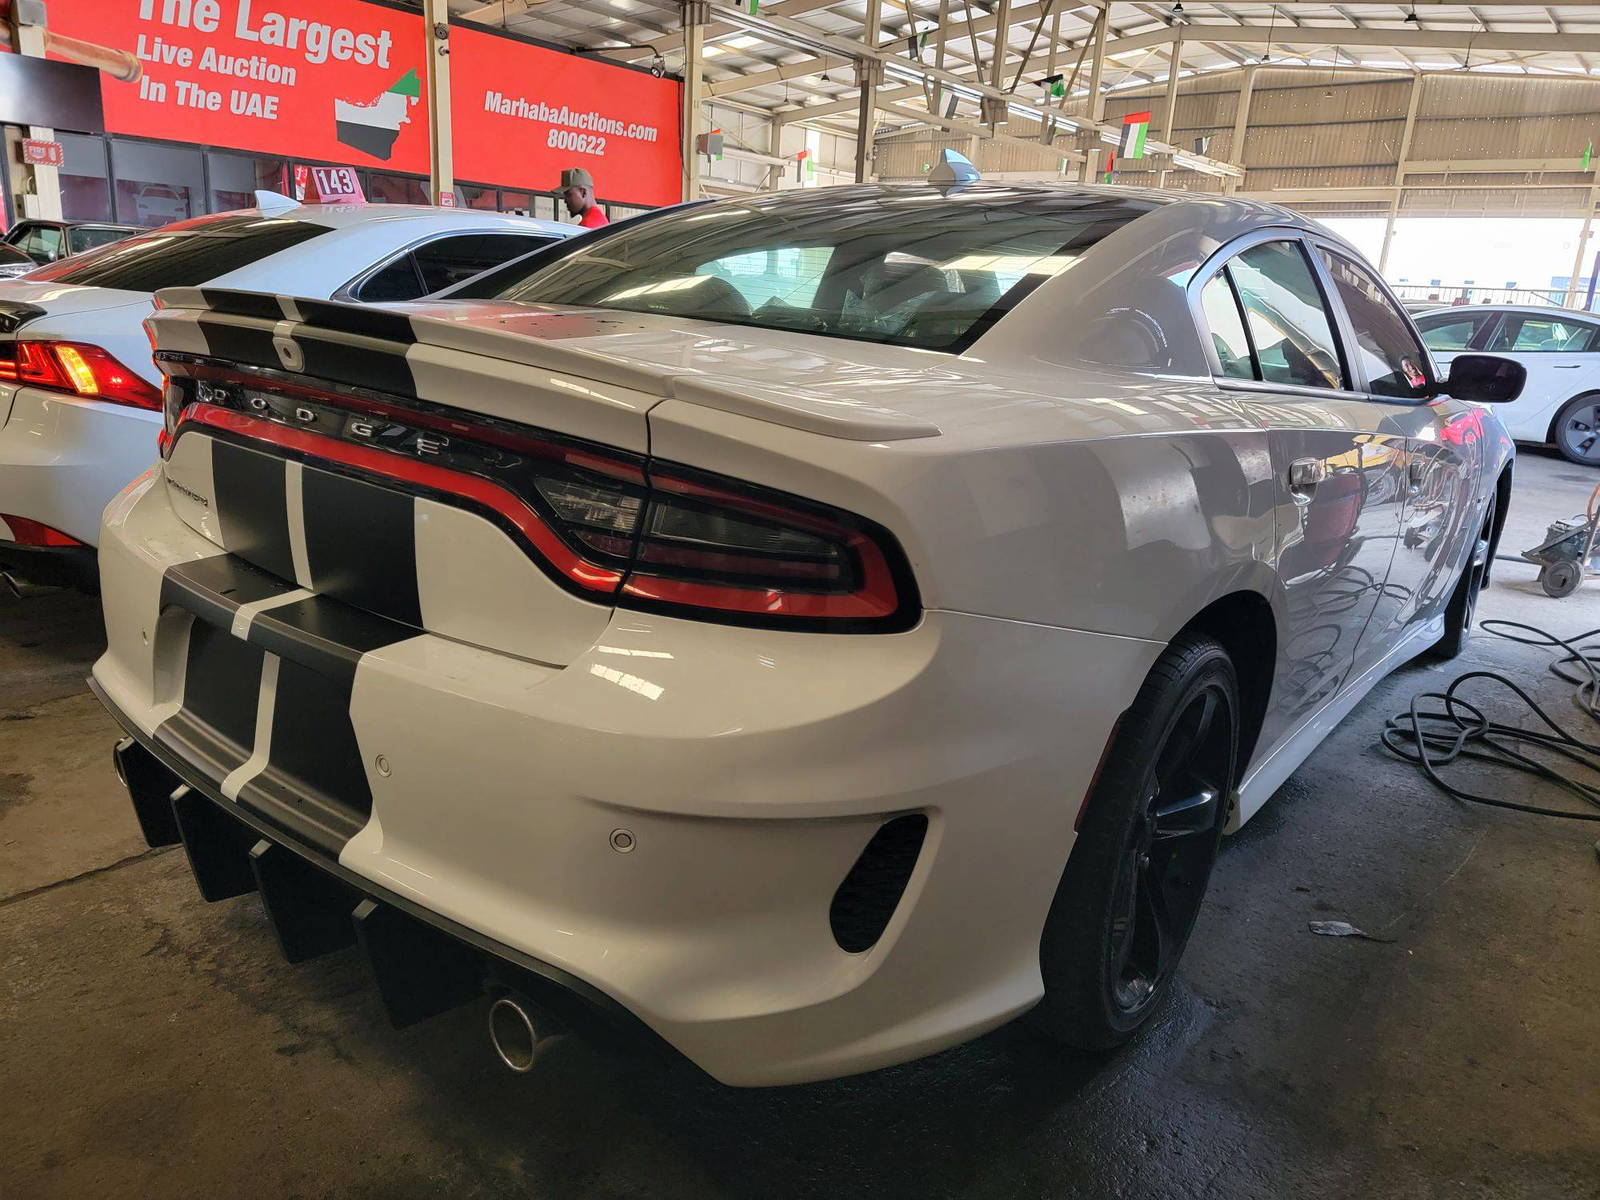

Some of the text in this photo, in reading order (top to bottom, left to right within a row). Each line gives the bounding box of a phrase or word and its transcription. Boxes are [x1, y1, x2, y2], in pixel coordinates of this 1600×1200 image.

[235, 0, 392, 69] Largest
[136, 34, 297, 86] Live Auction
[139, 75, 279, 120] In The UAE
[484, 90, 658, 142] MarhabaAuctions.com
[547, 128, 606, 156] 800622
[318, 169, 354, 195] 143
